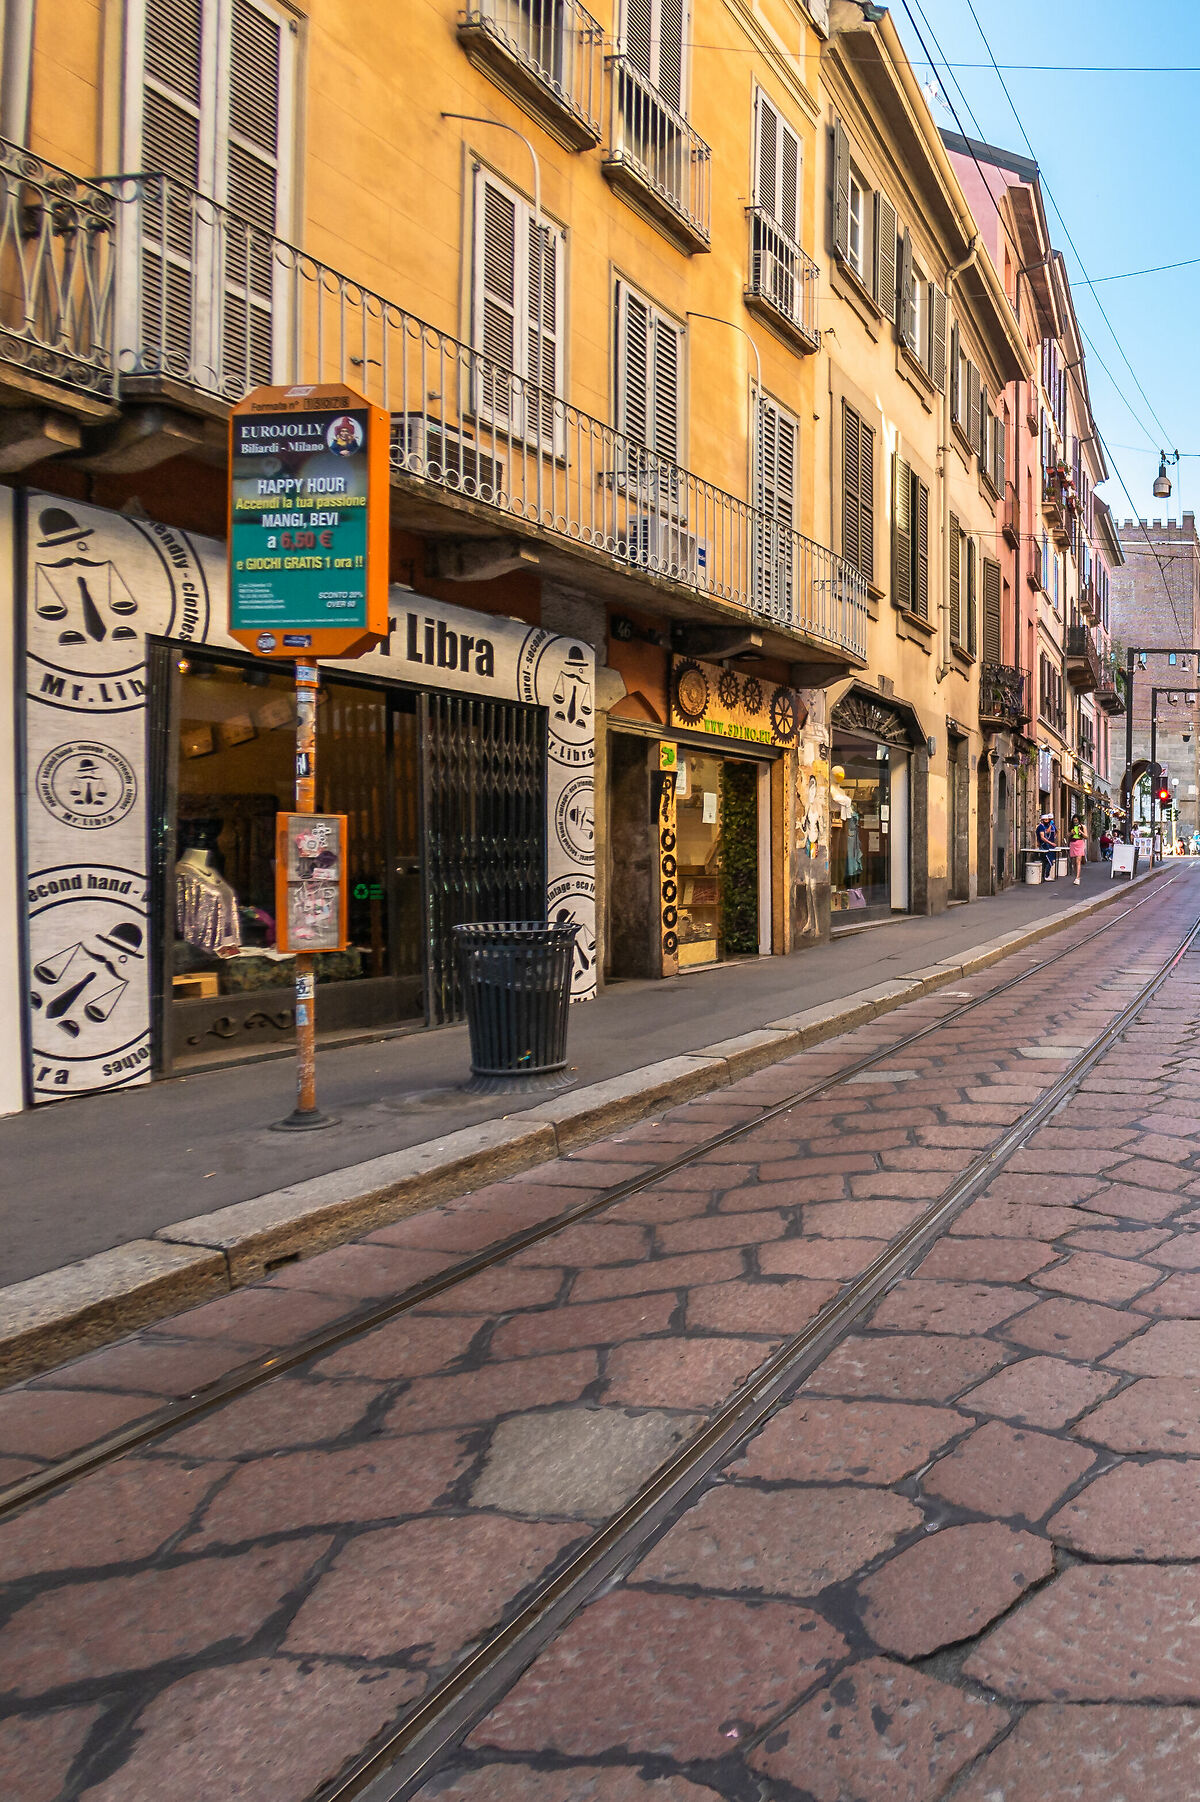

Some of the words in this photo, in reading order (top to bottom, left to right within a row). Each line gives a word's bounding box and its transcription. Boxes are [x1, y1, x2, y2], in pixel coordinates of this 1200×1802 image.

[241, 423, 324, 438] EUROJOLLY
[241, 443, 279, 453] Biliardi
[288, 442, 324, 452] Milano
[258, 478, 303, 494] HAPPY
[307, 477, 345, 493] HOUR
[236, 497, 279, 509] Accendi
[282, 497, 293, 508] la
[296, 497, 313, 508] tua
[316, 496, 366, 509] passione
[262, 513, 307, 529] MANGI,
[310, 512, 339, 526] BEVI
[267, 535, 277, 549] a
[281, 532, 315, 551] 6,50
[320, 530, 334, 548] €
[236, 561, 243, 570] e
[246, 557, 281, 570] GIOCHI
[284, 556, 322, 569] GRATIS
[325, 556, 331, 568] 1
[334, 557, 352, 568] ora
[407, 613, 494, 678] Libra
[87, 874, 132, 894] hand
[576, 881, 589, 890] eco
